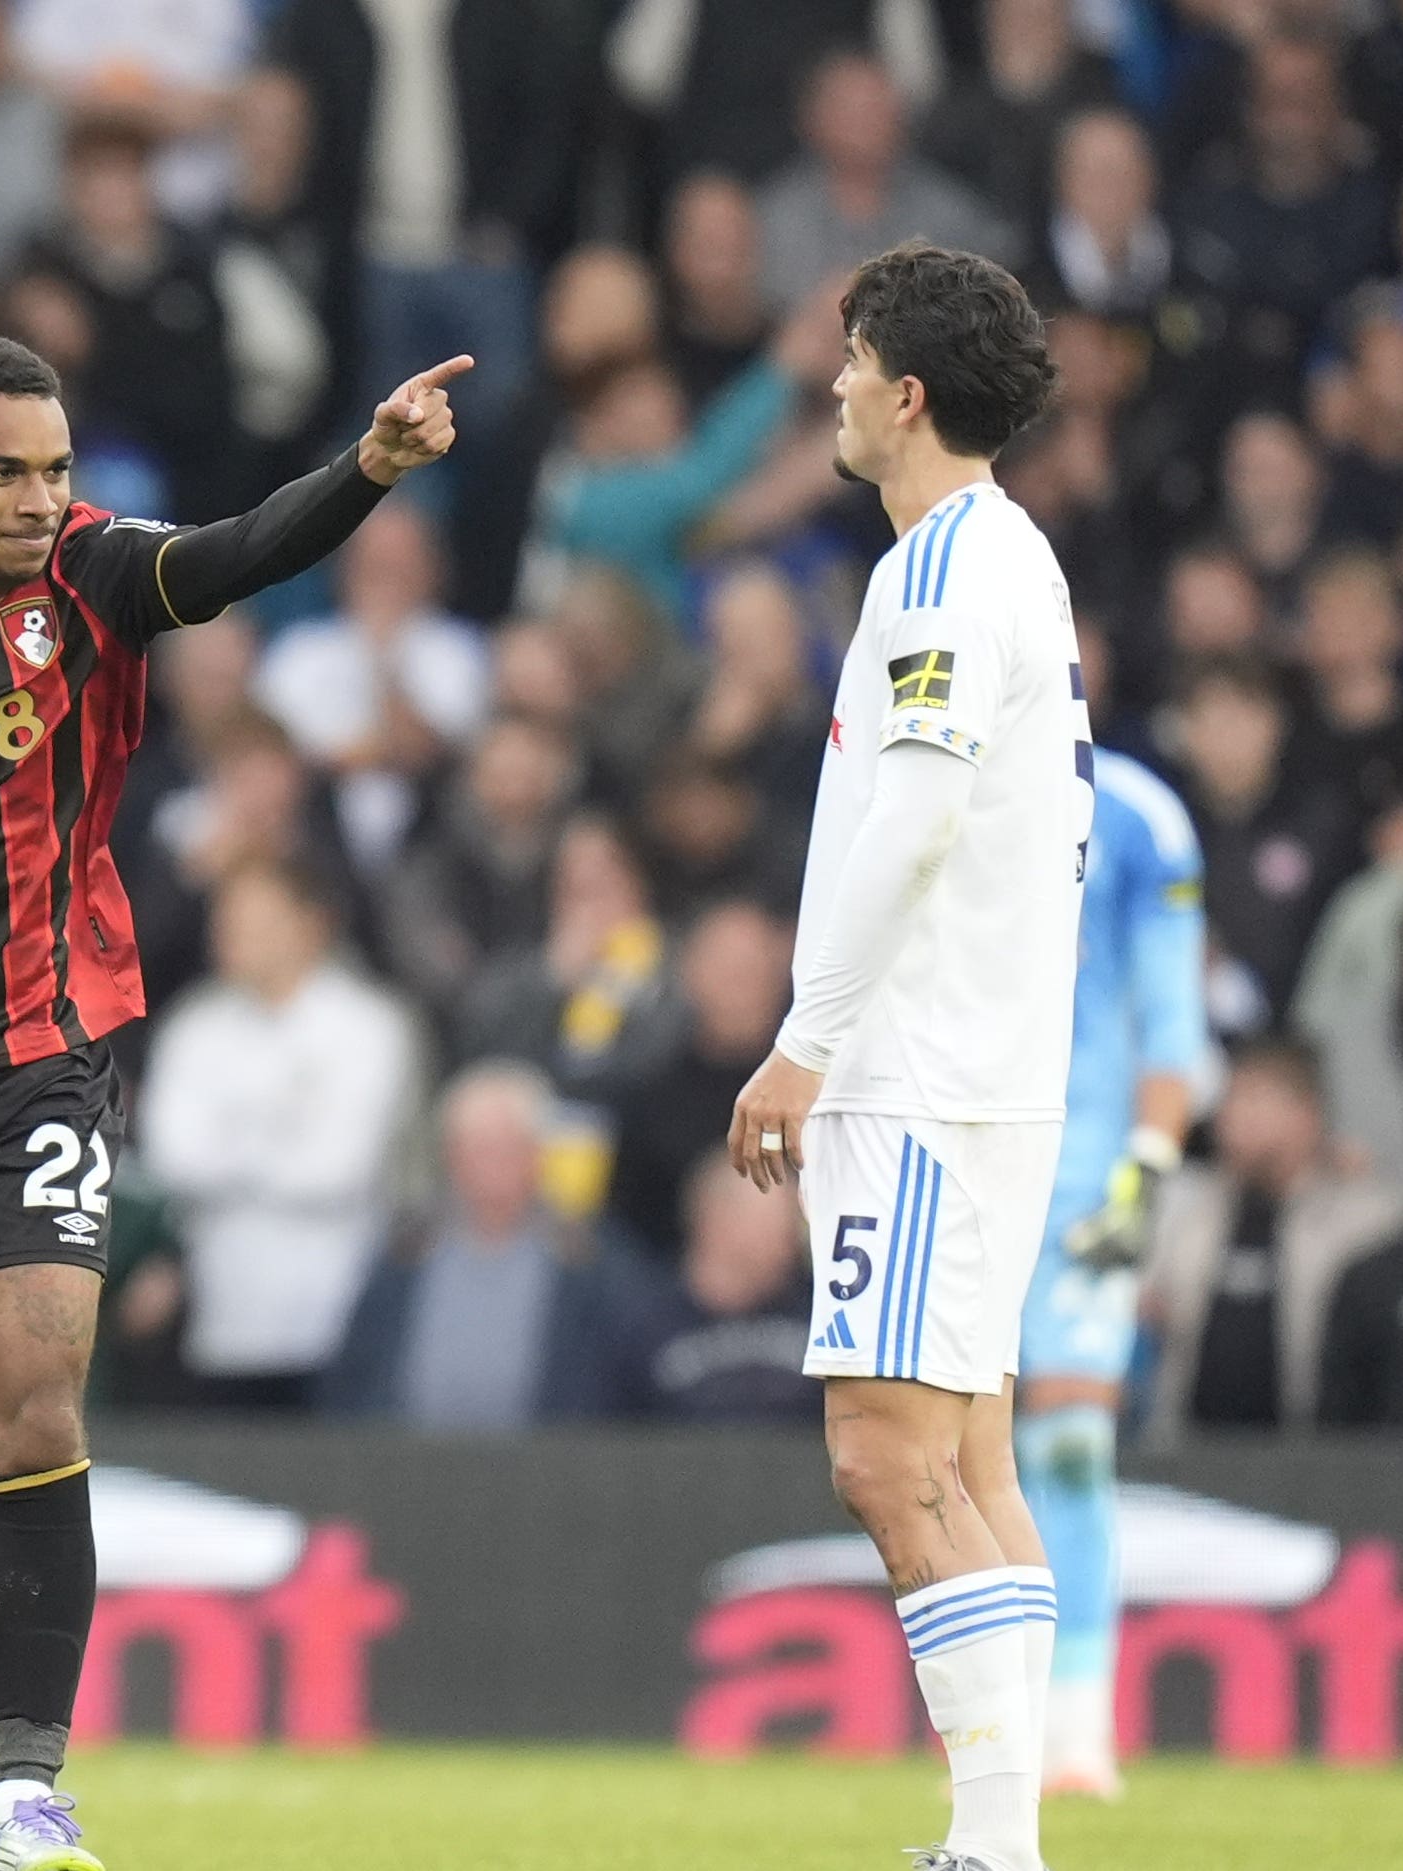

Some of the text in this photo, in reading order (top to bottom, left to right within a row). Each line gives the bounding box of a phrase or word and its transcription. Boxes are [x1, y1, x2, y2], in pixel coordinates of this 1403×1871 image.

[23, 1122, 111, 1217] 22
[58, 1232, 96, 1247] umbro
[828, 1214, 878, 1301] 5
